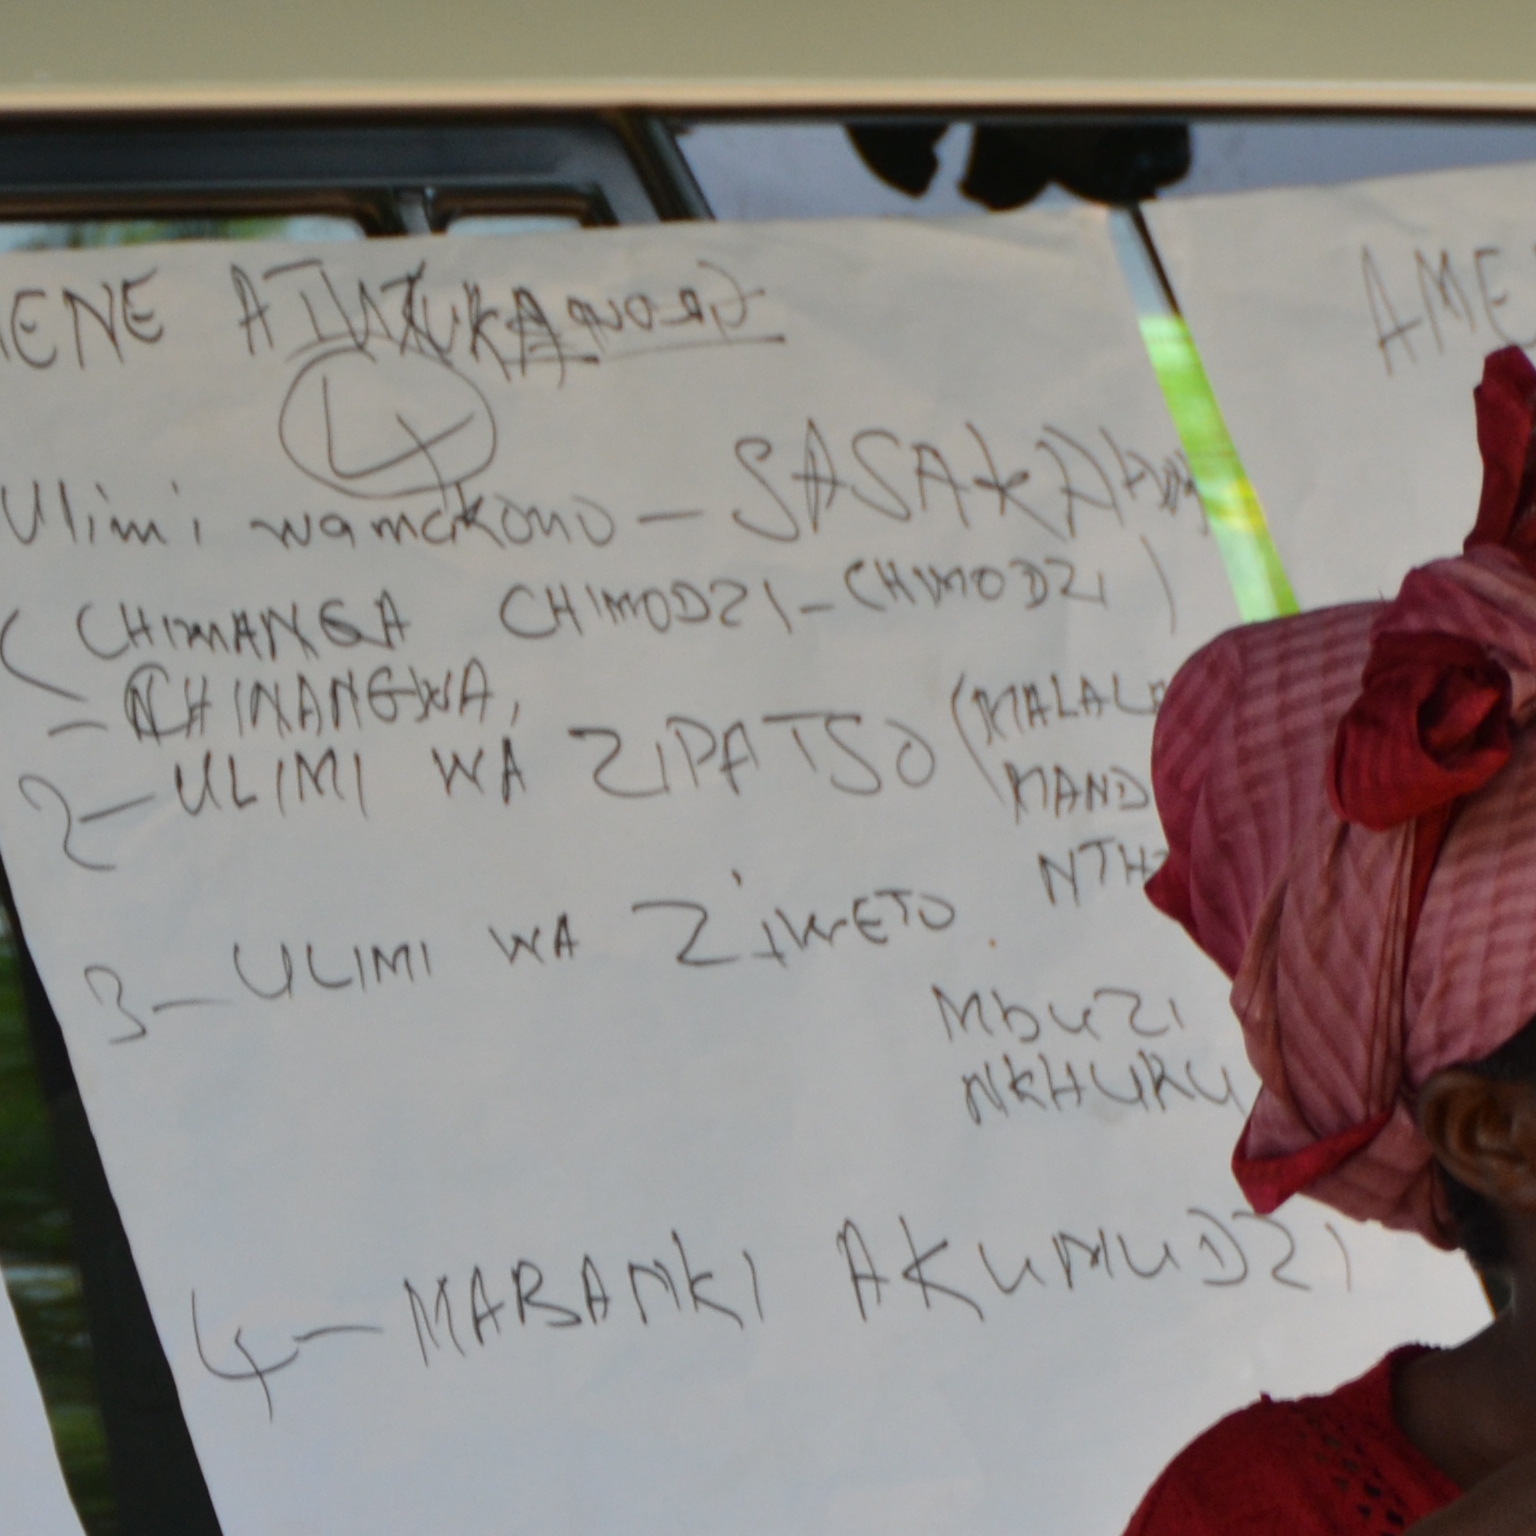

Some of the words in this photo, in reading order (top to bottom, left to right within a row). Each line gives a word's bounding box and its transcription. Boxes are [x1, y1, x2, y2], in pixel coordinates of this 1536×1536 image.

[322, 372, 476, 512] 4
[174, 746, 368, 818] ULIMI
[432, 734, 528, 806] WA
[567, 710, 938, 799] ZIPATSO
[231, 938, 434, 1003] ULIMI
[487, 908, 580, 966] WA
